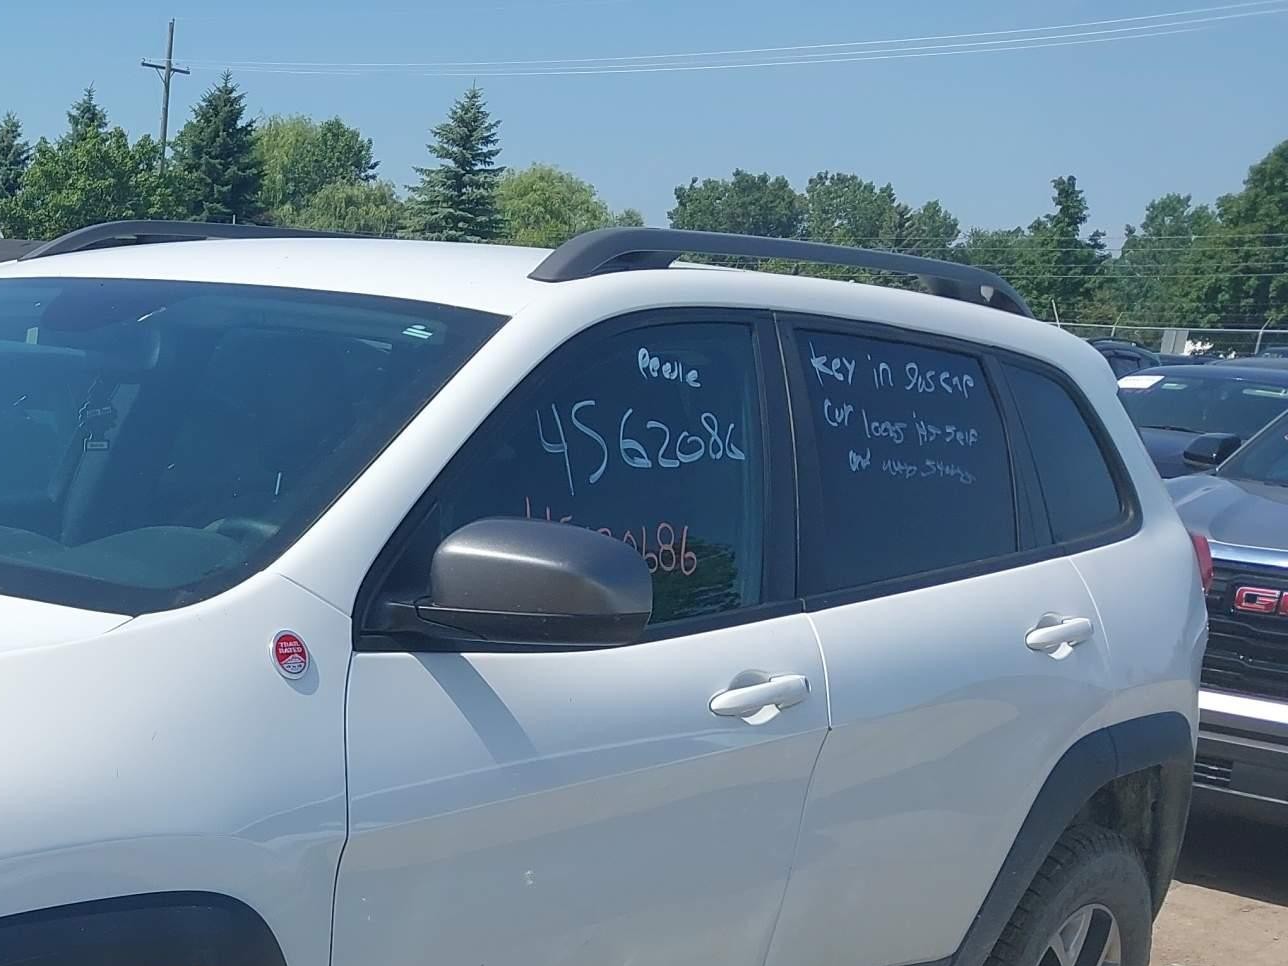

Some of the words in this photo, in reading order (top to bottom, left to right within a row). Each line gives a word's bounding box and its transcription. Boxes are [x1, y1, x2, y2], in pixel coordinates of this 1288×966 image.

[866, 353, 894, 390] in
[535, 400, 746, 497] 4562086
[1234, 586, 1288, 616] G
[278, 640, 301, 648] TRAIL
